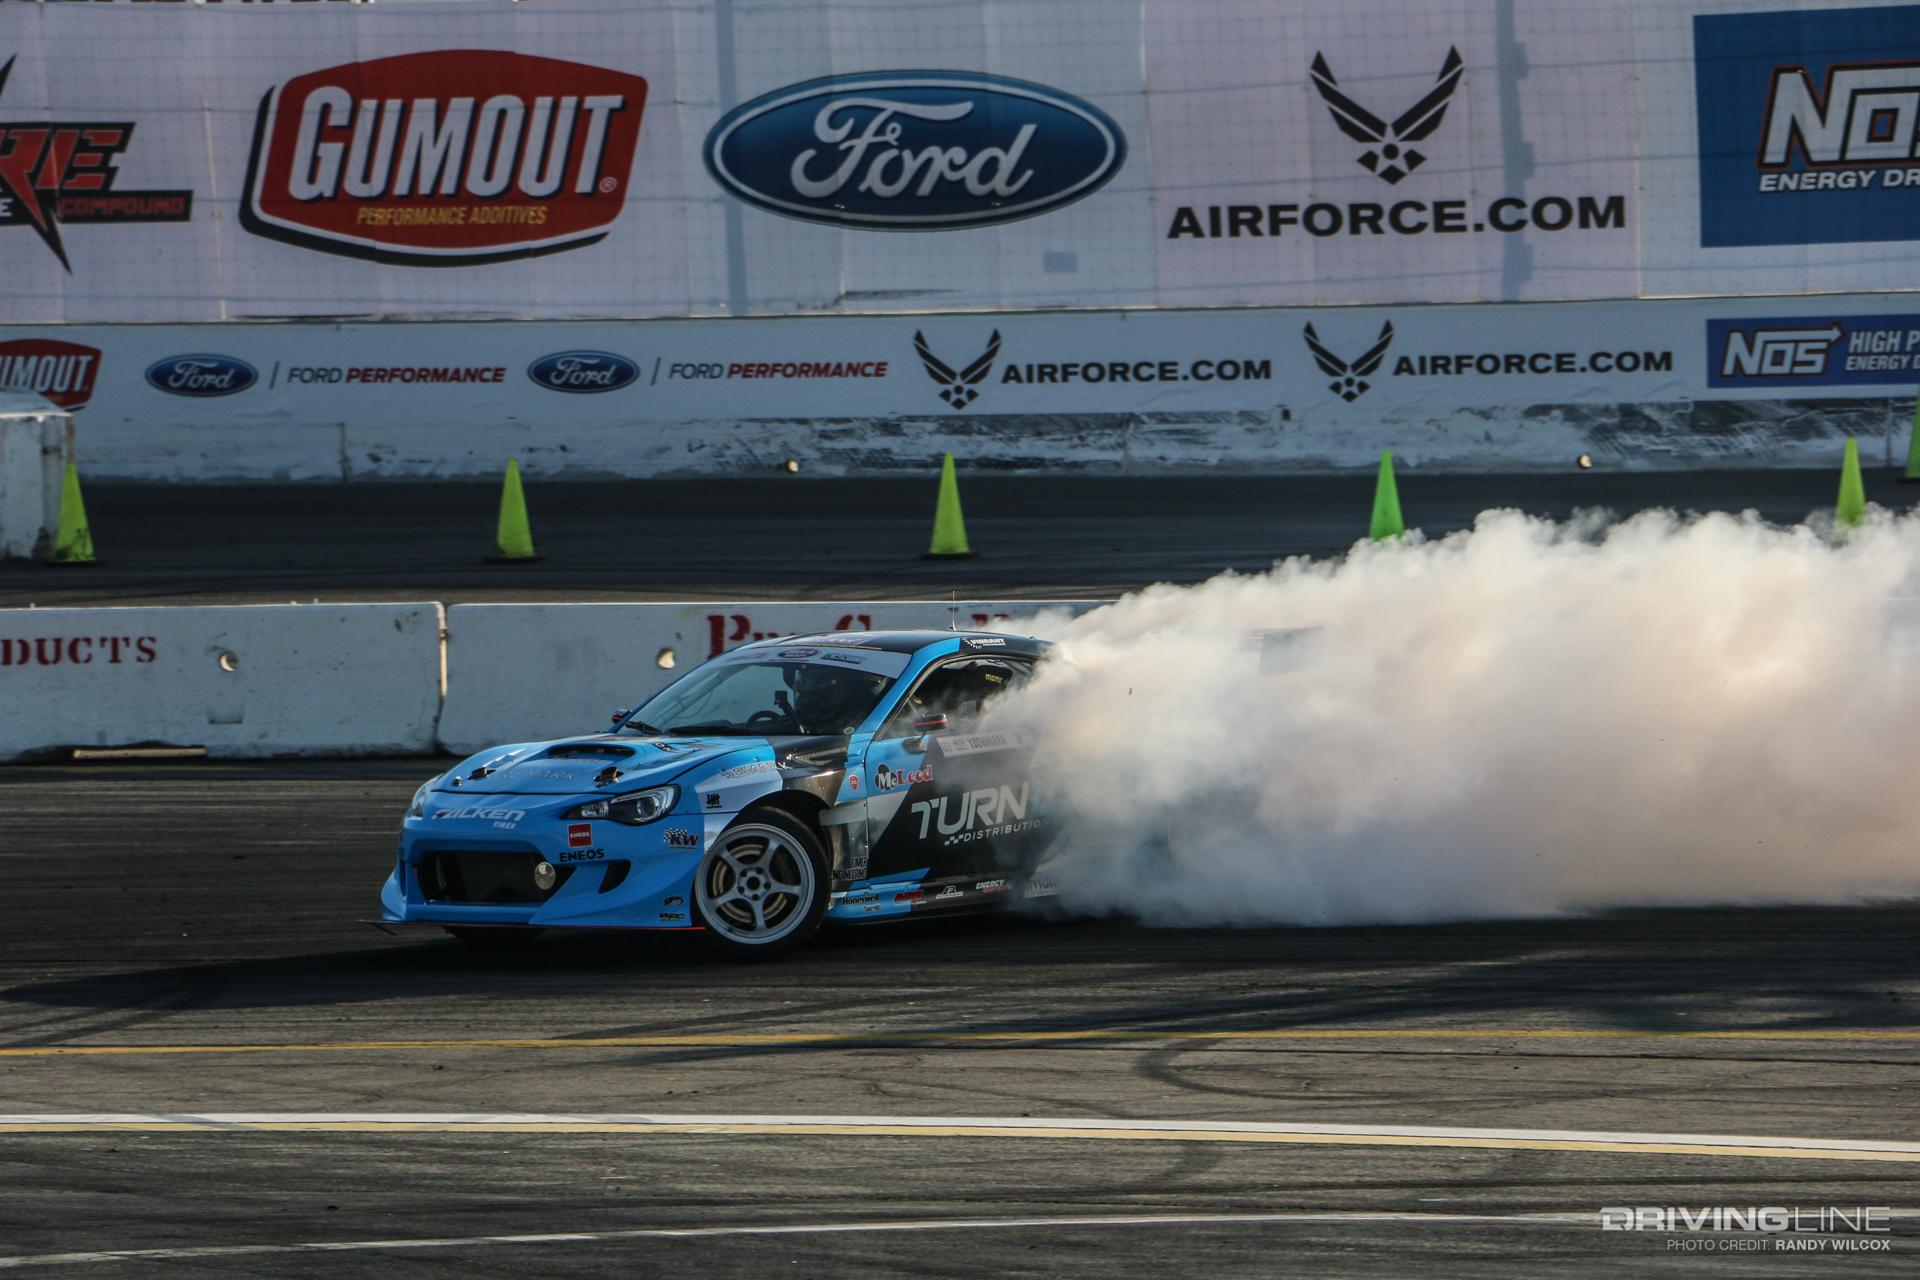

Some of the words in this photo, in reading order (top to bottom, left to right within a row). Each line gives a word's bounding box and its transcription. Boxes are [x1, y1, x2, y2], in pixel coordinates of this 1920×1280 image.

[1757, 64, 1920, 168] NO
[288, 86, 624, 200] GUMOUT
[790, 98, 1037, 198] Ford
[1758, 169, 1877, 192] ENERGY
[60, 197, 185, 214] COMPOUND
[357, 207, 467, 226] PERFORMANCE
[469, 205, 548, 225] ADDITIVES
[1166, 196, 1626, 240] AIRFORCE.COM
[1721, 325, 1843, 377] NOS
[1848, 330, 1902, 353] HIGH
[550, 358, 617, 386] Ford
[669, 363, 724, 379] FORD
[726, 362, 889, 379] PERFORMANCE
[1001, 360, 1272, 384] AIRFORCE.COM
[1393, 351, 1673, 376] AIRFORCE.COM
[1844, 354, 1911, 371] ENERGY
[168, 360, 236, 389] Ford
[287, 368, 343, 383] FORD
[345, 367, 507, 383] PERFORMANCE
[0, 636, 158, 666] DUCTS
[431, 808, 526, 822] FALKEN
[492, 821, 517, 830] TIRES
[570, 831, 590, 839] ENEOS
[963, 817, 1050, 843] DISTRIBUTION
[559, 848, 605, 863] ENEOS
[842, 894, 880, 906] Honeywell
